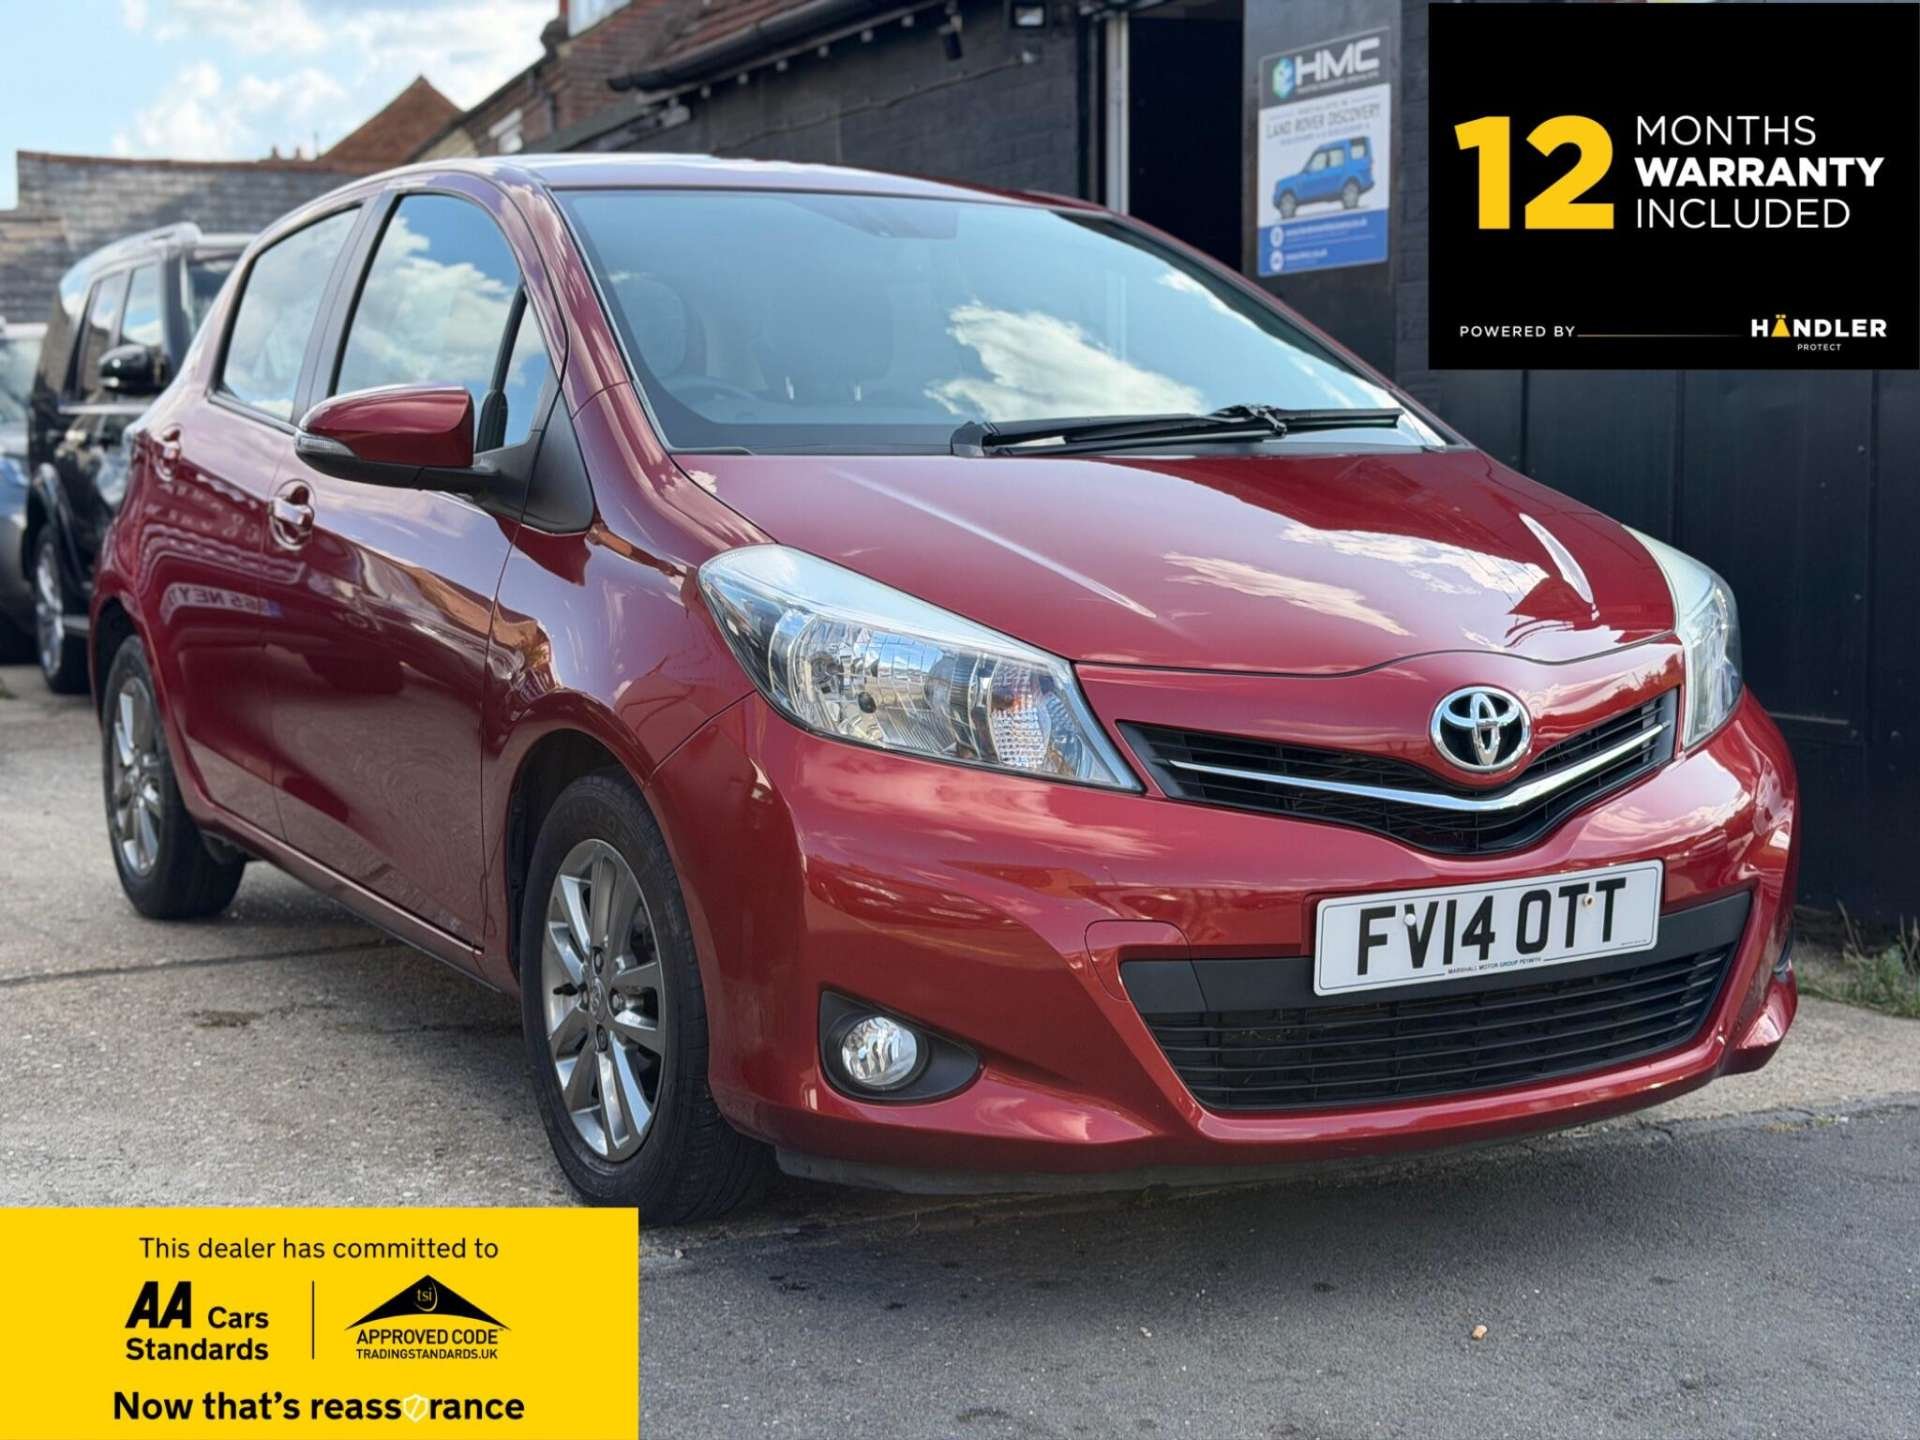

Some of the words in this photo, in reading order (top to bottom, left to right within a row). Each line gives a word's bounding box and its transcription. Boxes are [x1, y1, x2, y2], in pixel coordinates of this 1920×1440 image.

[1295, 36, 1381, 86] HMC
[1357, 896, 1496, 976] FV14
[1516, 877, 1627, 955] OTT
[1447, 965, 1477, 975] MARSHALL
[1478, 961, 1499, 971] MOTOR
[1499, 959, 1519, 968] GROUP
